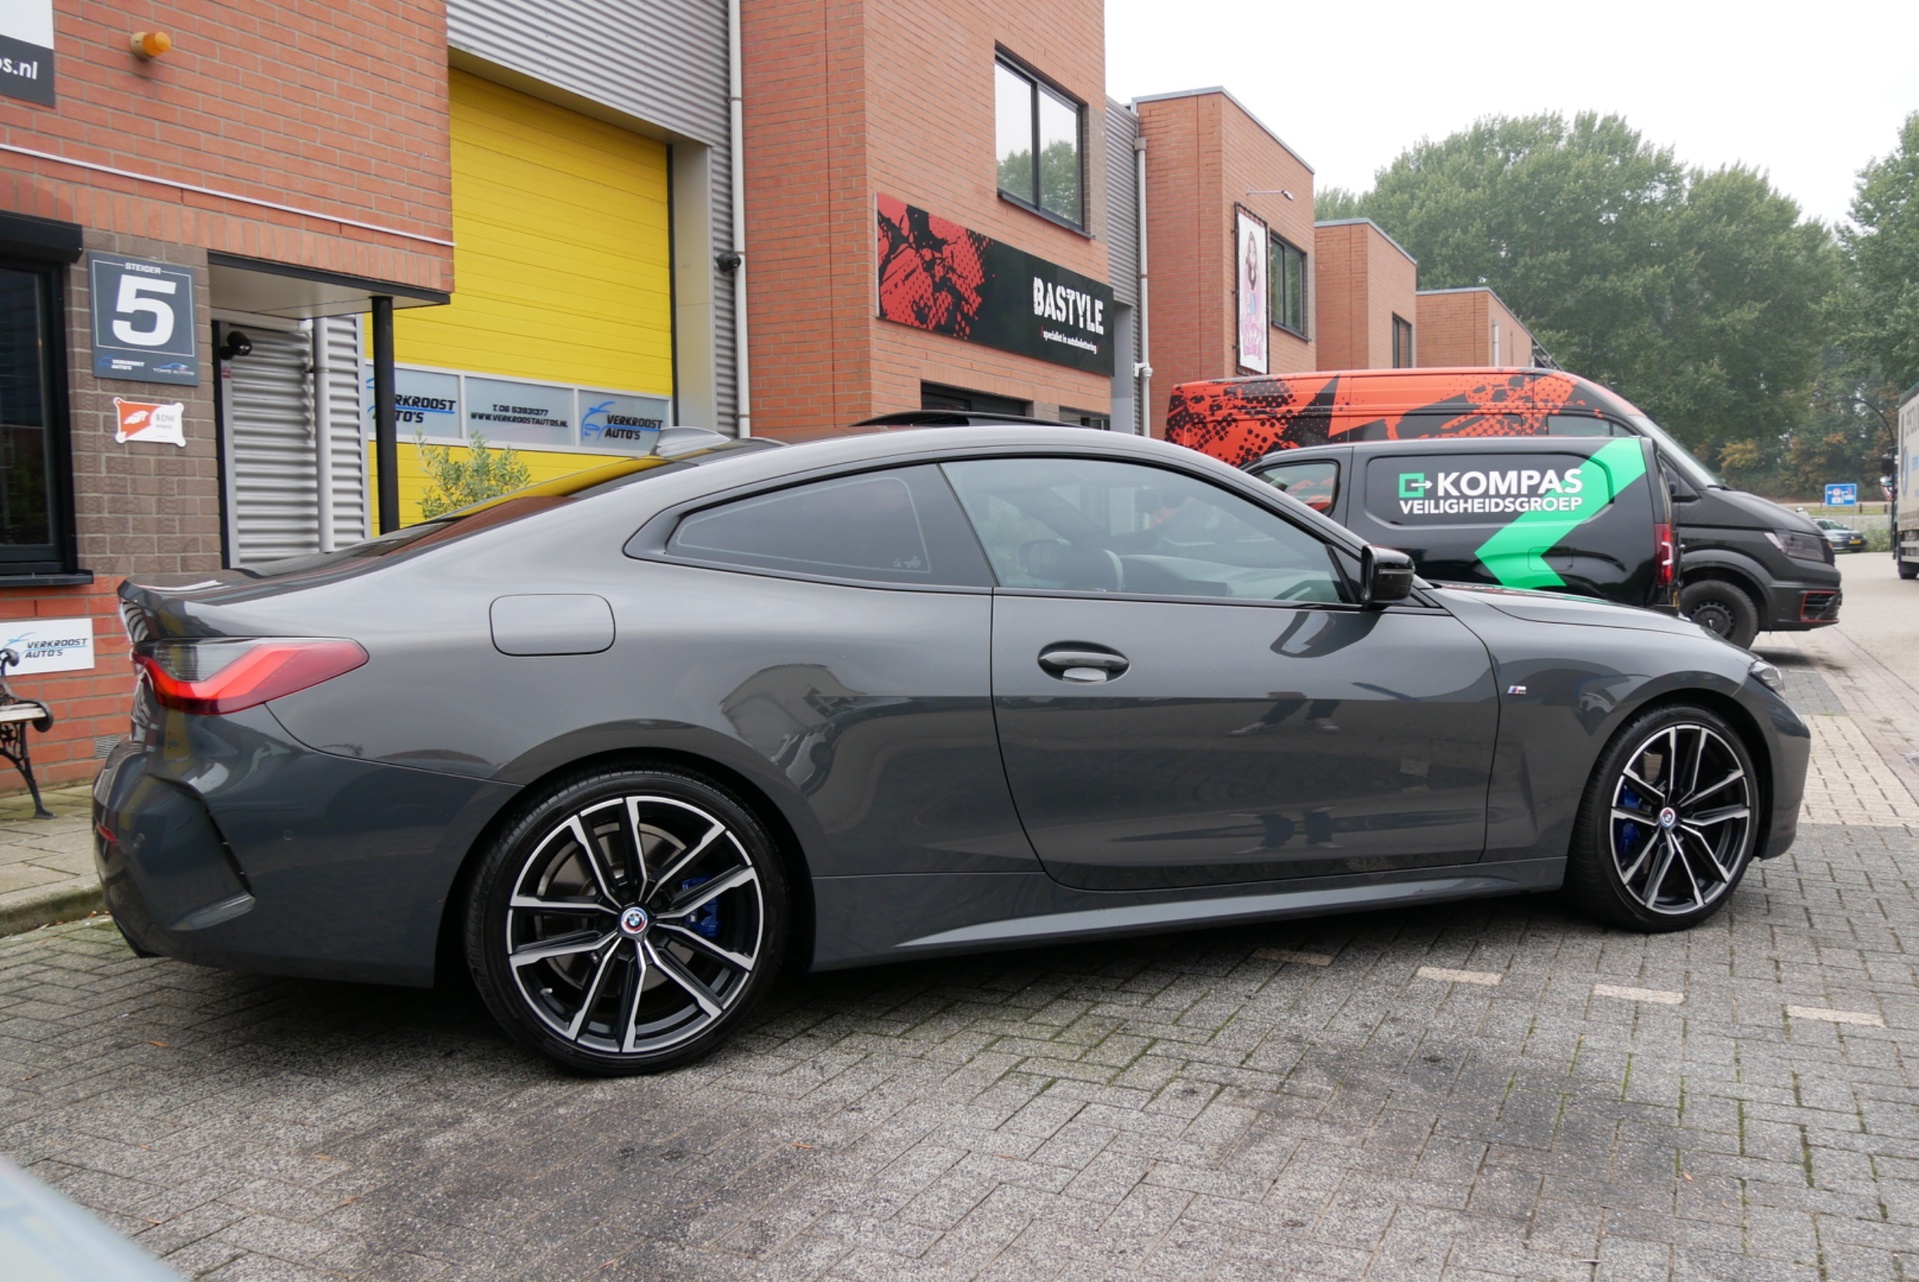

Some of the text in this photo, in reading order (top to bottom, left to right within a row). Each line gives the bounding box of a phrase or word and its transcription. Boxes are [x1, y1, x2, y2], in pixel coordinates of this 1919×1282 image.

[124, 262, 162, 275] STEIGER
[112, 274, 177, 346] 5
[1033, 276, 1104, 335] BASTYLE
[607, 414, 663, 430] VERKROOST
[604, 428, 641, 441] AUTO'S
[1437, 468, 1583, 497] KOMPAS
[1399, 498, 1583, 515] VEILIGHEIDSGROEP
[27, 638, 88, 650] VERKROOST
[25, 649, 63, 659] AUTO'S
